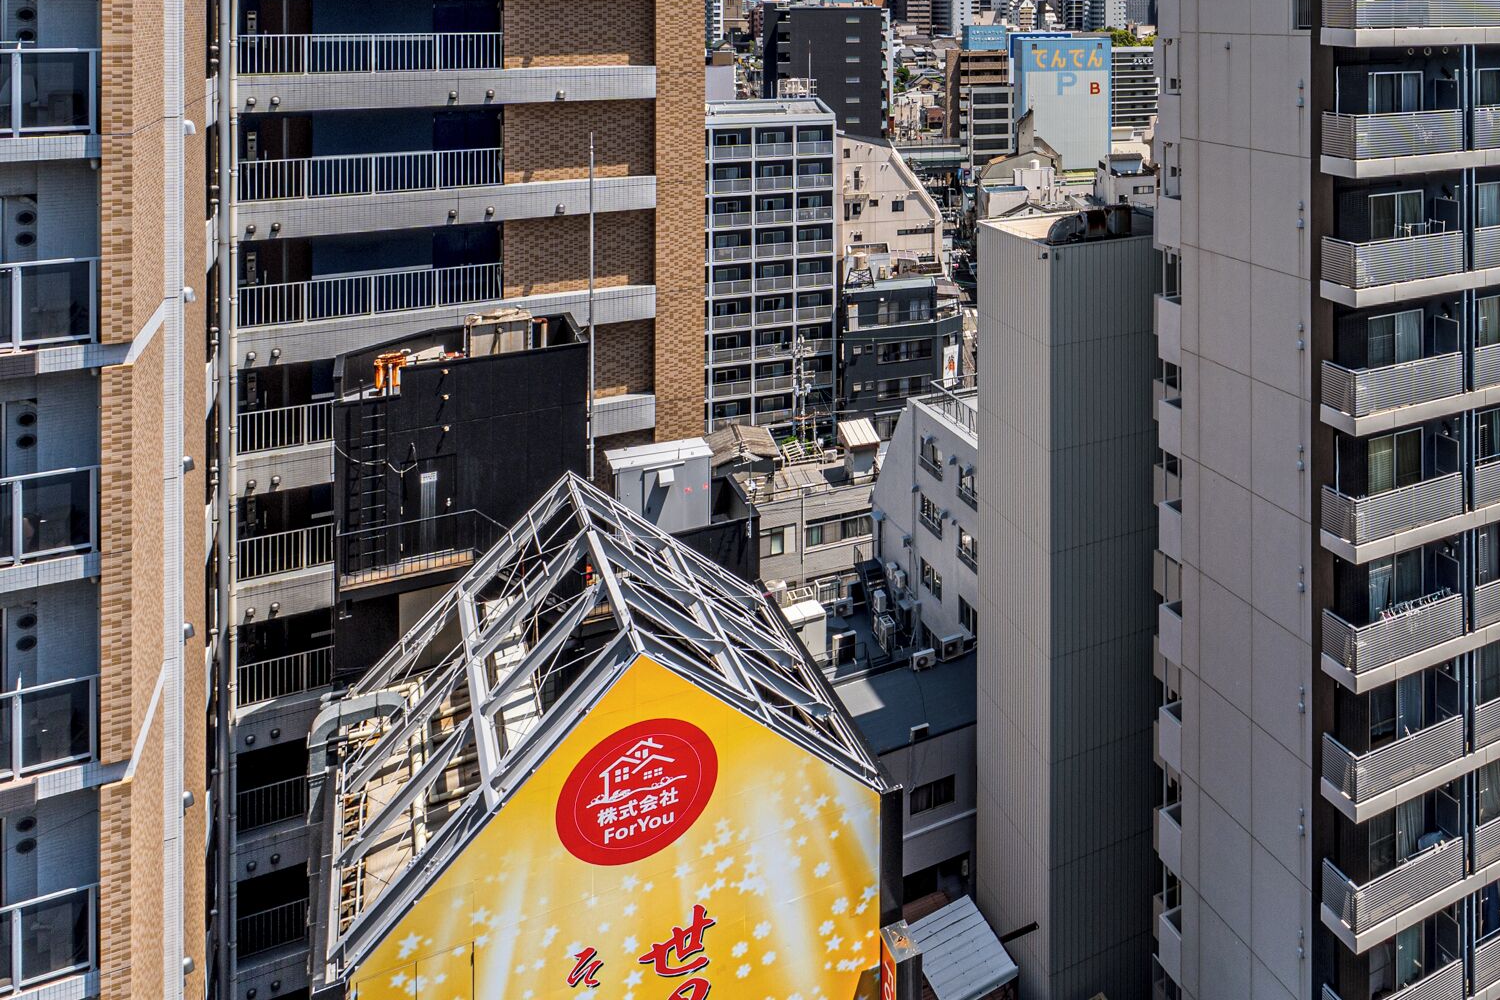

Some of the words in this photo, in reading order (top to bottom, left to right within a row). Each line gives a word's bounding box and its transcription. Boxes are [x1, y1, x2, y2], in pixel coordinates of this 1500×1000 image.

[1032, 50, 1103, 69] でんでん
[1056, 72, 1078, 96] P
[1089, 82, 1101, 95] B
[597, 786, 679, 827] 株式会社
[604, 812, 675, 845] ForYou
